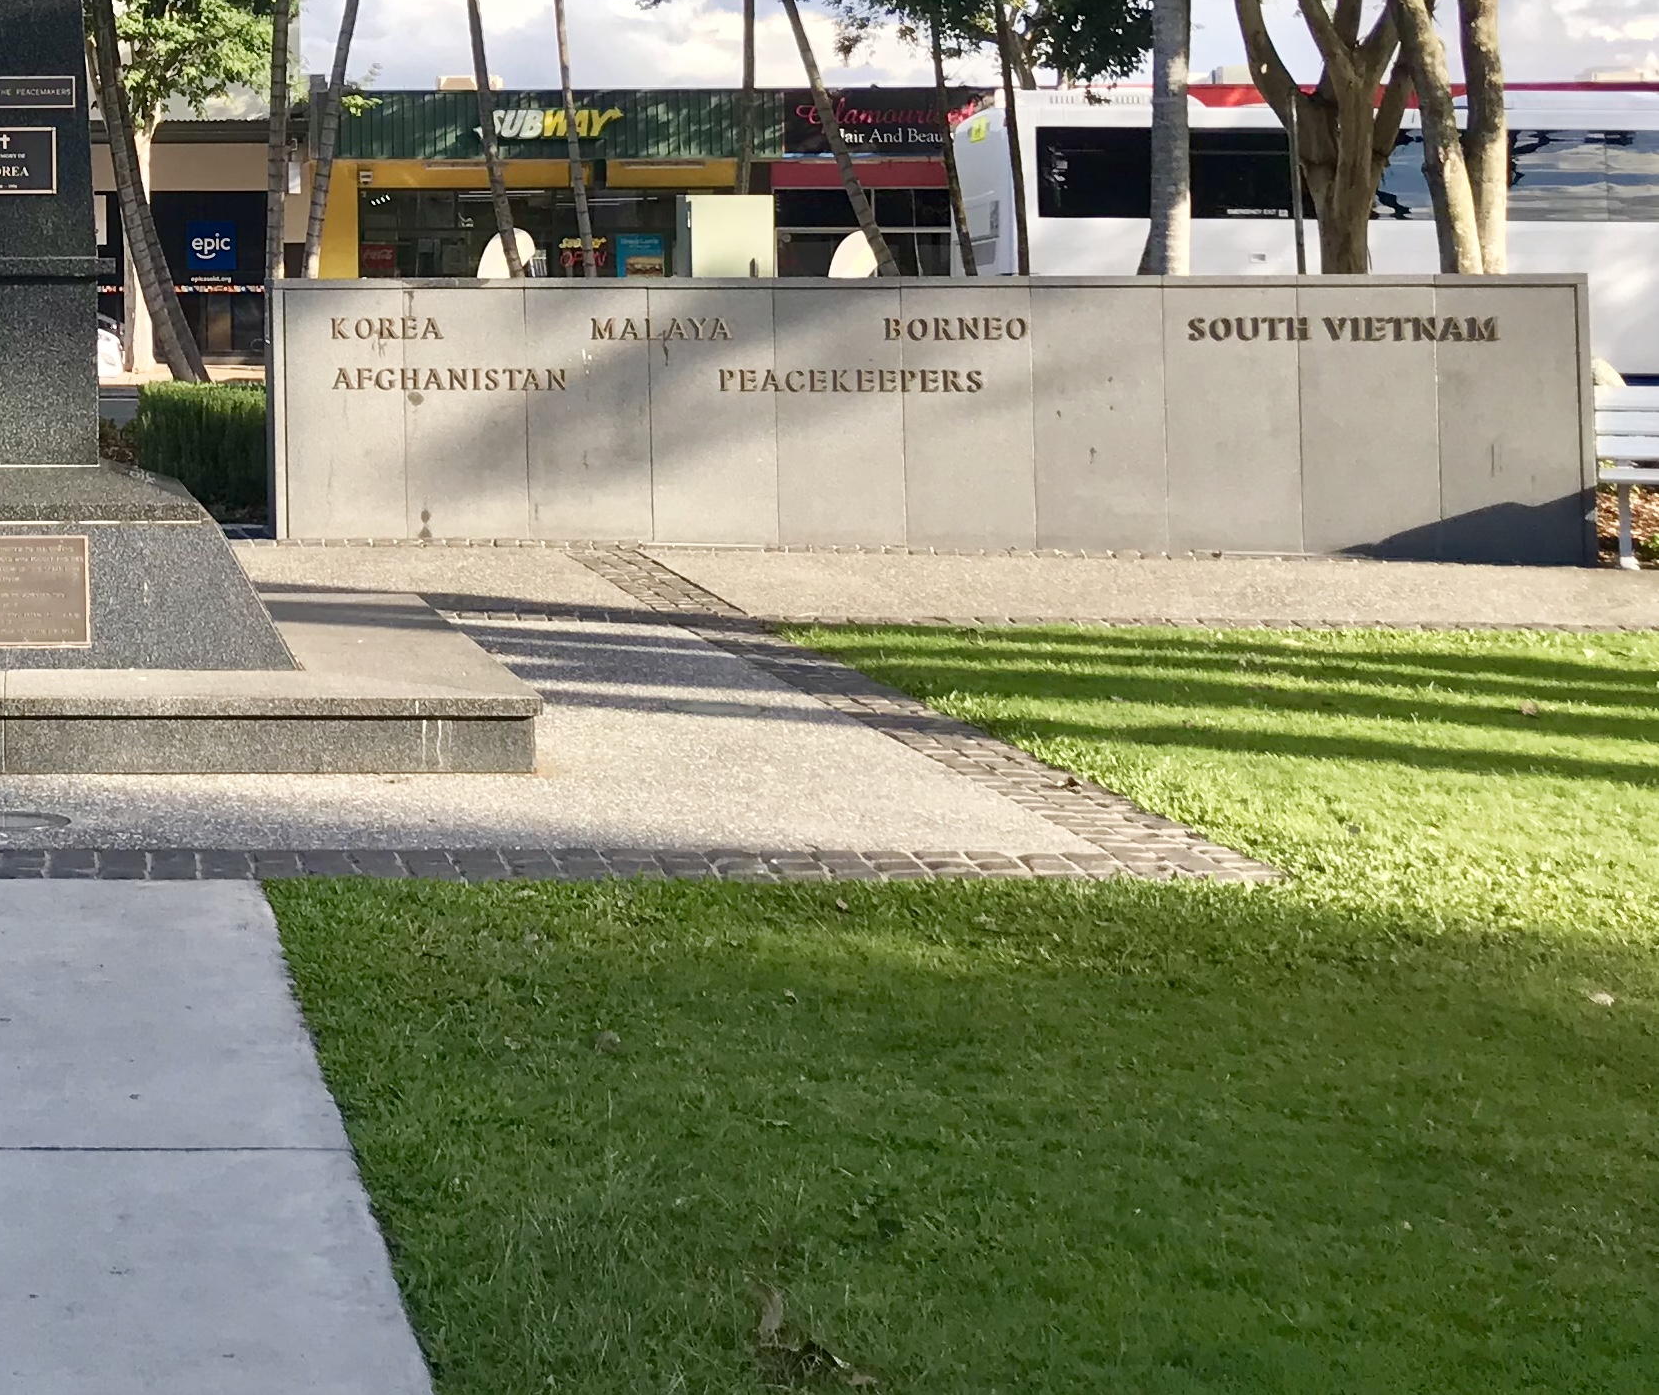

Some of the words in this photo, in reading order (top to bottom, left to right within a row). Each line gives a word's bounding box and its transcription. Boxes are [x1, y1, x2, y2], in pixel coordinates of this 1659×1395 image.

[16, 88, 71, 96] PEACEMAKERS
[473, 106, 624, 139] SUBWAY
[869, 128, 902, 143] And
[908, 129, 943, 143] Beau
[191, 232, 231, 255] epic
[559, 251, 607, 267] OPN
[330, 316, 444, 340] KOREA
[590, 316, 734, 341] MALAYA
[882, 316, 1029, 341] BORNEO
[1186, 316, 1312, 342] SOUTH
[1322, 315, 1500, 342] VIETNAM
[331, 367, 568, 391] AFGHANISTAN
[718, 368, 984, 393] PEACEKEEPERS
